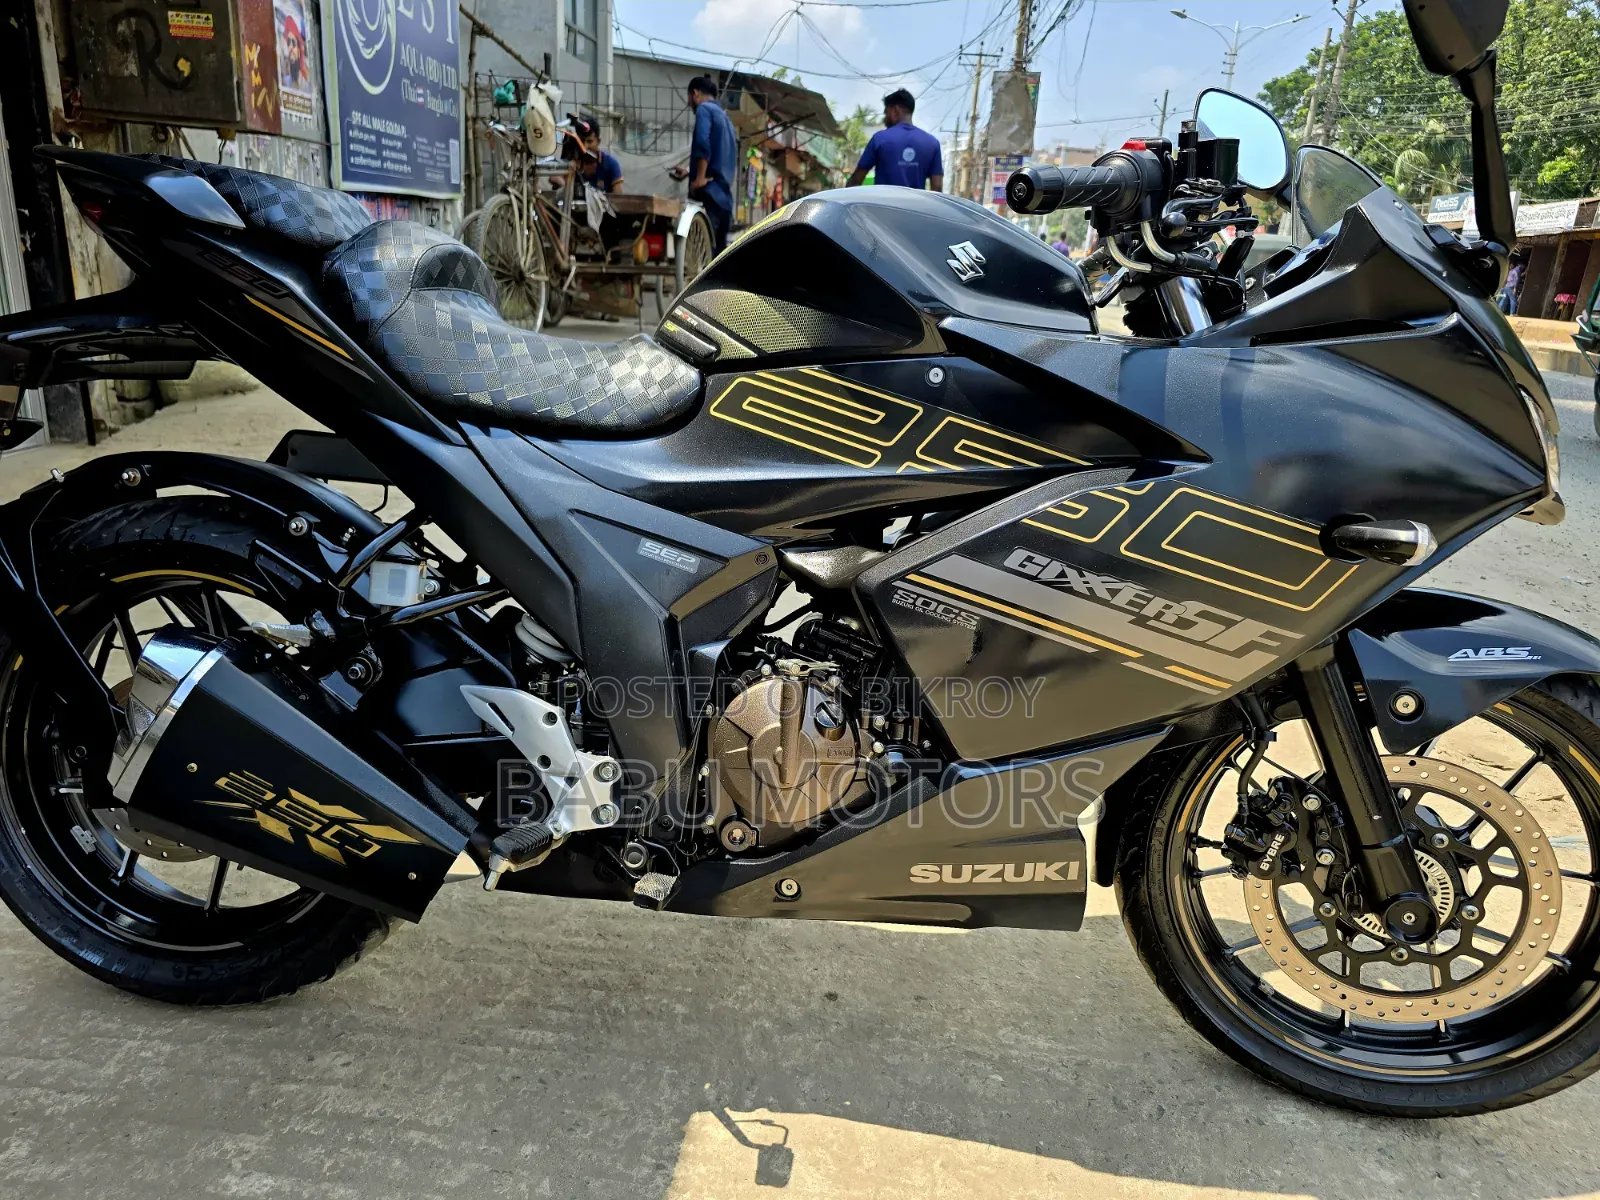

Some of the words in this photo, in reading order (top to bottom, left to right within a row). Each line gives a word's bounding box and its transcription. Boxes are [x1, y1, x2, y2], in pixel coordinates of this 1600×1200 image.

[400, 42, 425, 77] AQUA
[642, 541, 696, 563] SEP
[1003, 547, 1187, 627] GIXXER
[891, 599, 914, 610] SUZUKI
[925, 609, 951, 623] COOLING
[952, 619, 977, 631] SYSTEM
[893, 589, 980, 627] SOCS
[1447, 646, 1532, 661] ABS
[1259, 833, 1285, 871] BYBRE
[909, 860, 1080, 883] SUZUKI
